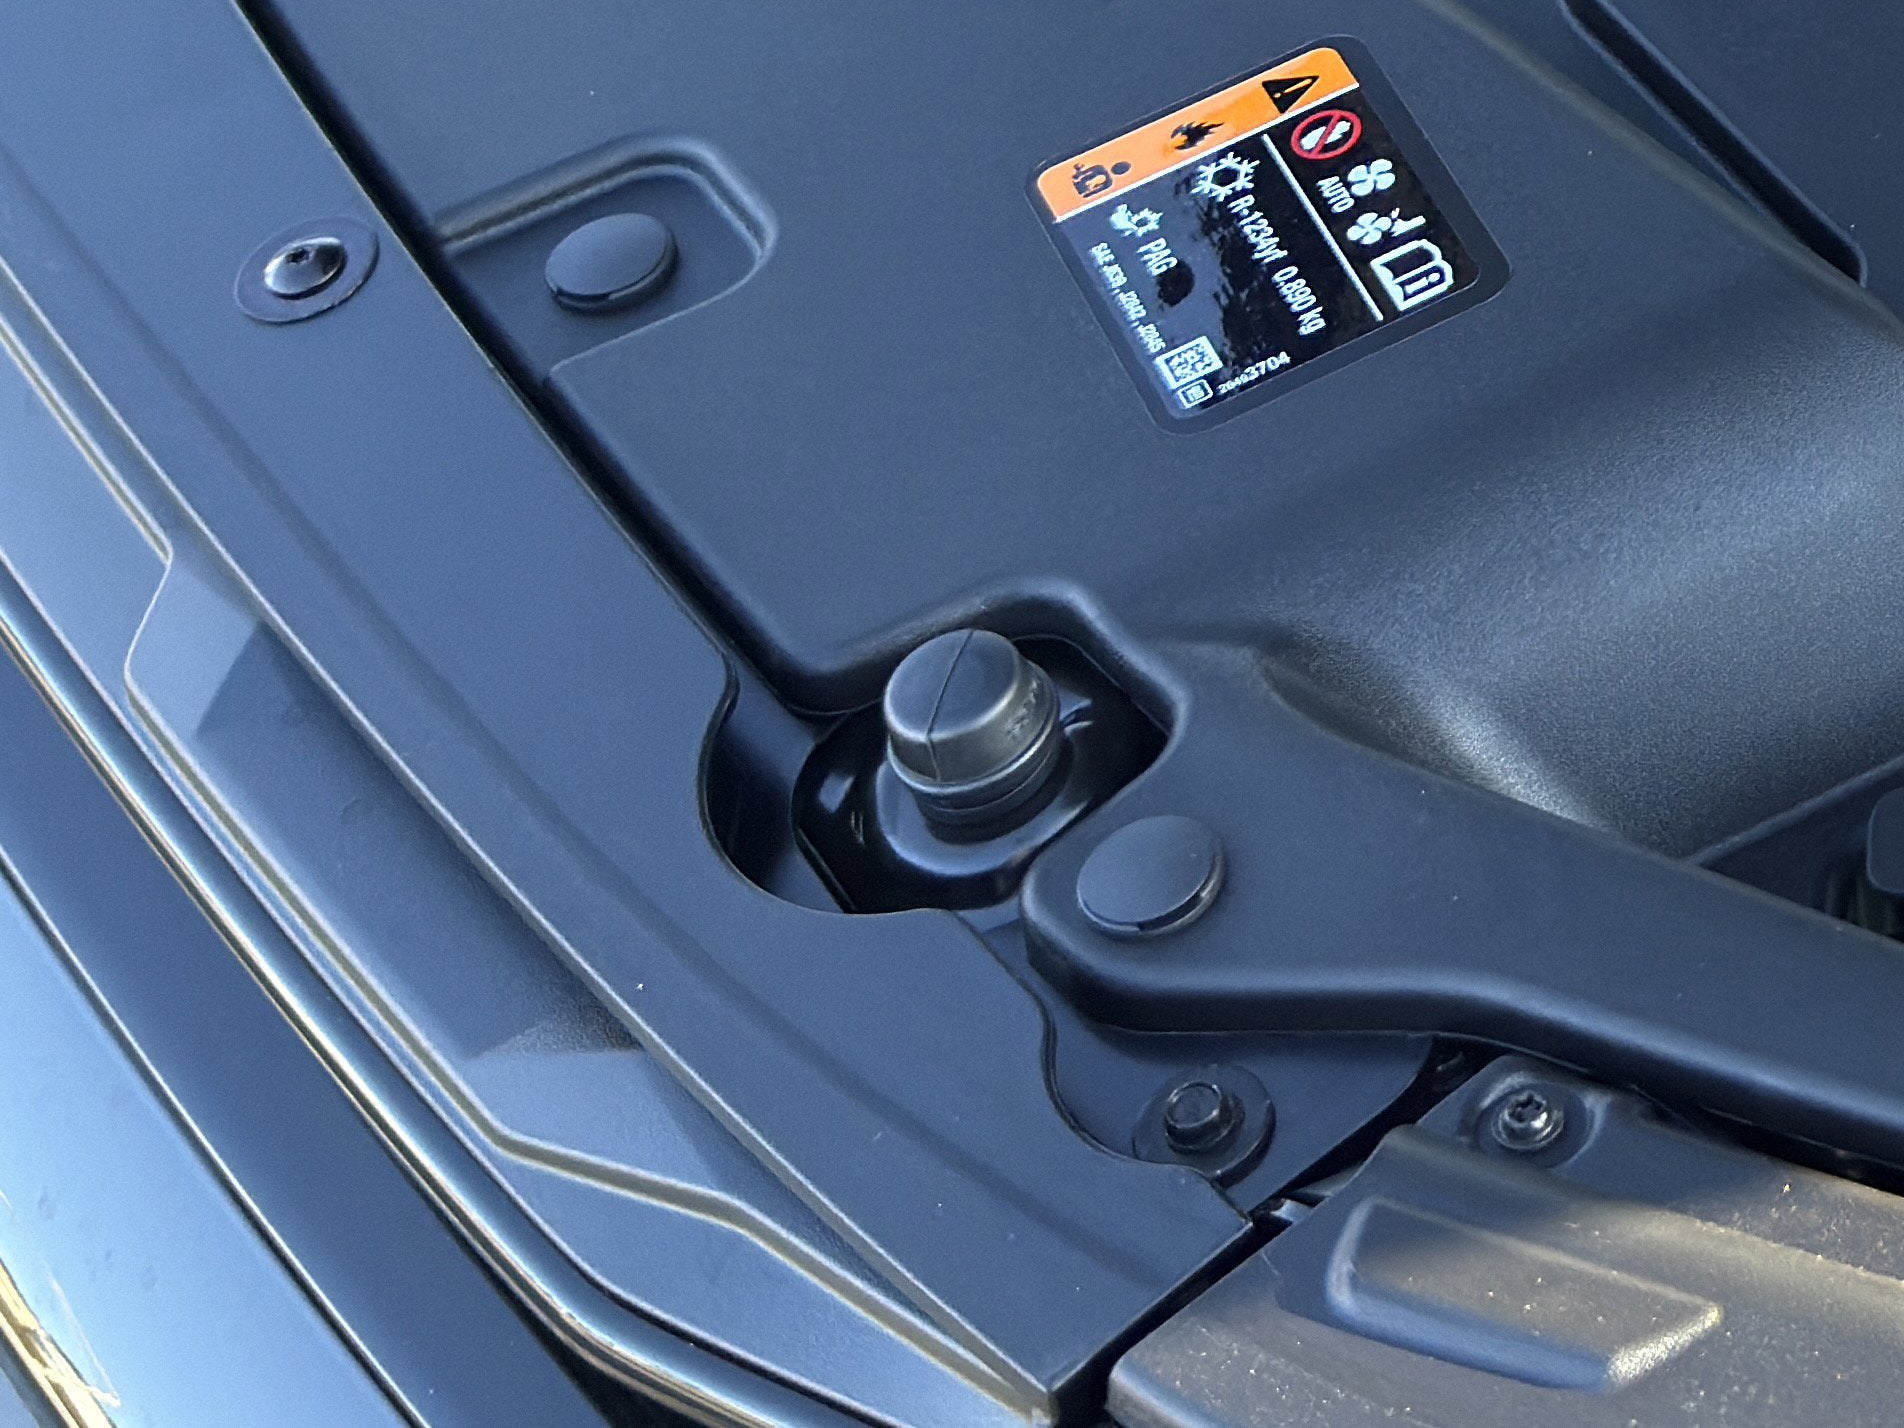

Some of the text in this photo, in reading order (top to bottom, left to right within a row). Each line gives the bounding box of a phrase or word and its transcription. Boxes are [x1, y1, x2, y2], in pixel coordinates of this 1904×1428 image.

[1316, 175, 1355, 213] AUTO
[1089, 242, 1115, 266] SAE
[1137, 237, 1178, 276] PAG
[1227, 194, 1327, 336] R-1234yf 0.890 kg
